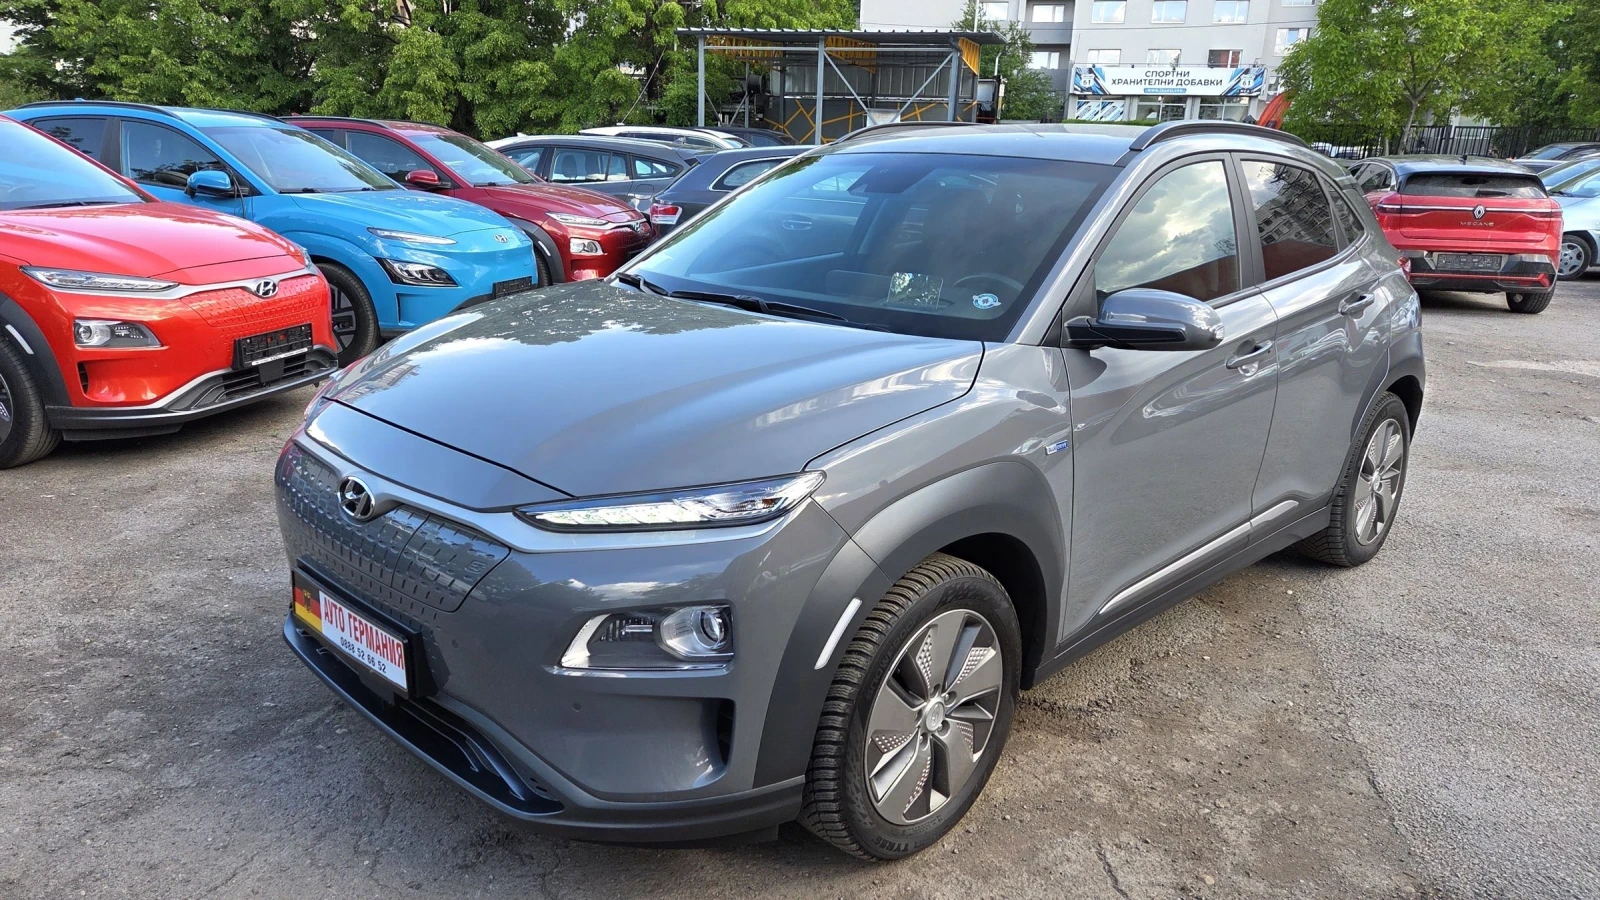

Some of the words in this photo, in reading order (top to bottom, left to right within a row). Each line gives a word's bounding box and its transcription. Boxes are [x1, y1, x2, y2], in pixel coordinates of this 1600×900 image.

[1111, 78, 1174, 86] ХРАНИТЕЛНИ
[1176, 79, 1223, 87] ДОБАВКИ
[1145, 70, 1190, 78] СПОРТНИ
[348, 612, 404, 670] ГЕРМАНИЯ
[340, 637, 356, 654] 0888
[357, 648, 365, 660] 52
[367, 654, 376, 667] 66
[378, 660, 387, 674] 52
